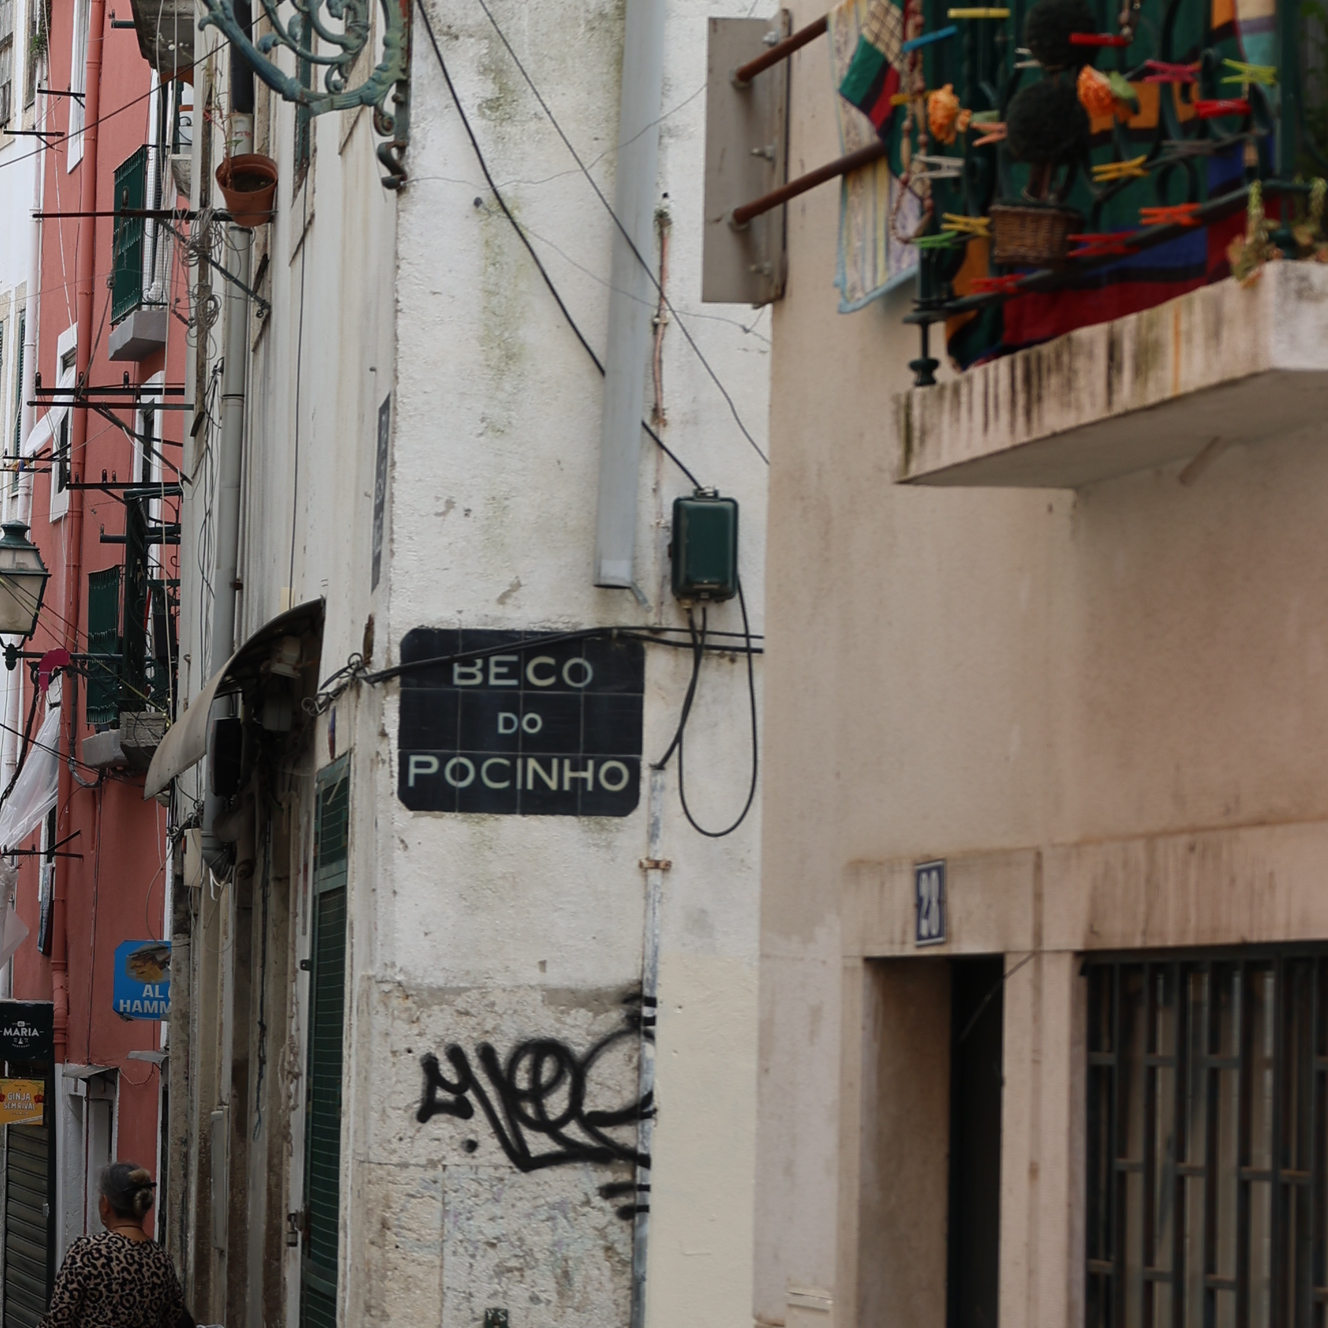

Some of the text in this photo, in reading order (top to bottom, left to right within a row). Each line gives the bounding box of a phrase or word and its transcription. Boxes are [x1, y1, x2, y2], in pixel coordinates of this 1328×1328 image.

[452, 653, 594, 688] BECO
[497, 711, 543, 734] DO
[408, 754, 630, 792] POCINHO
[142, 983, 165, 998] AL
[2, 1026, 40, 1037] MARIA
[7, 1092, 31, 1102] GINJA
